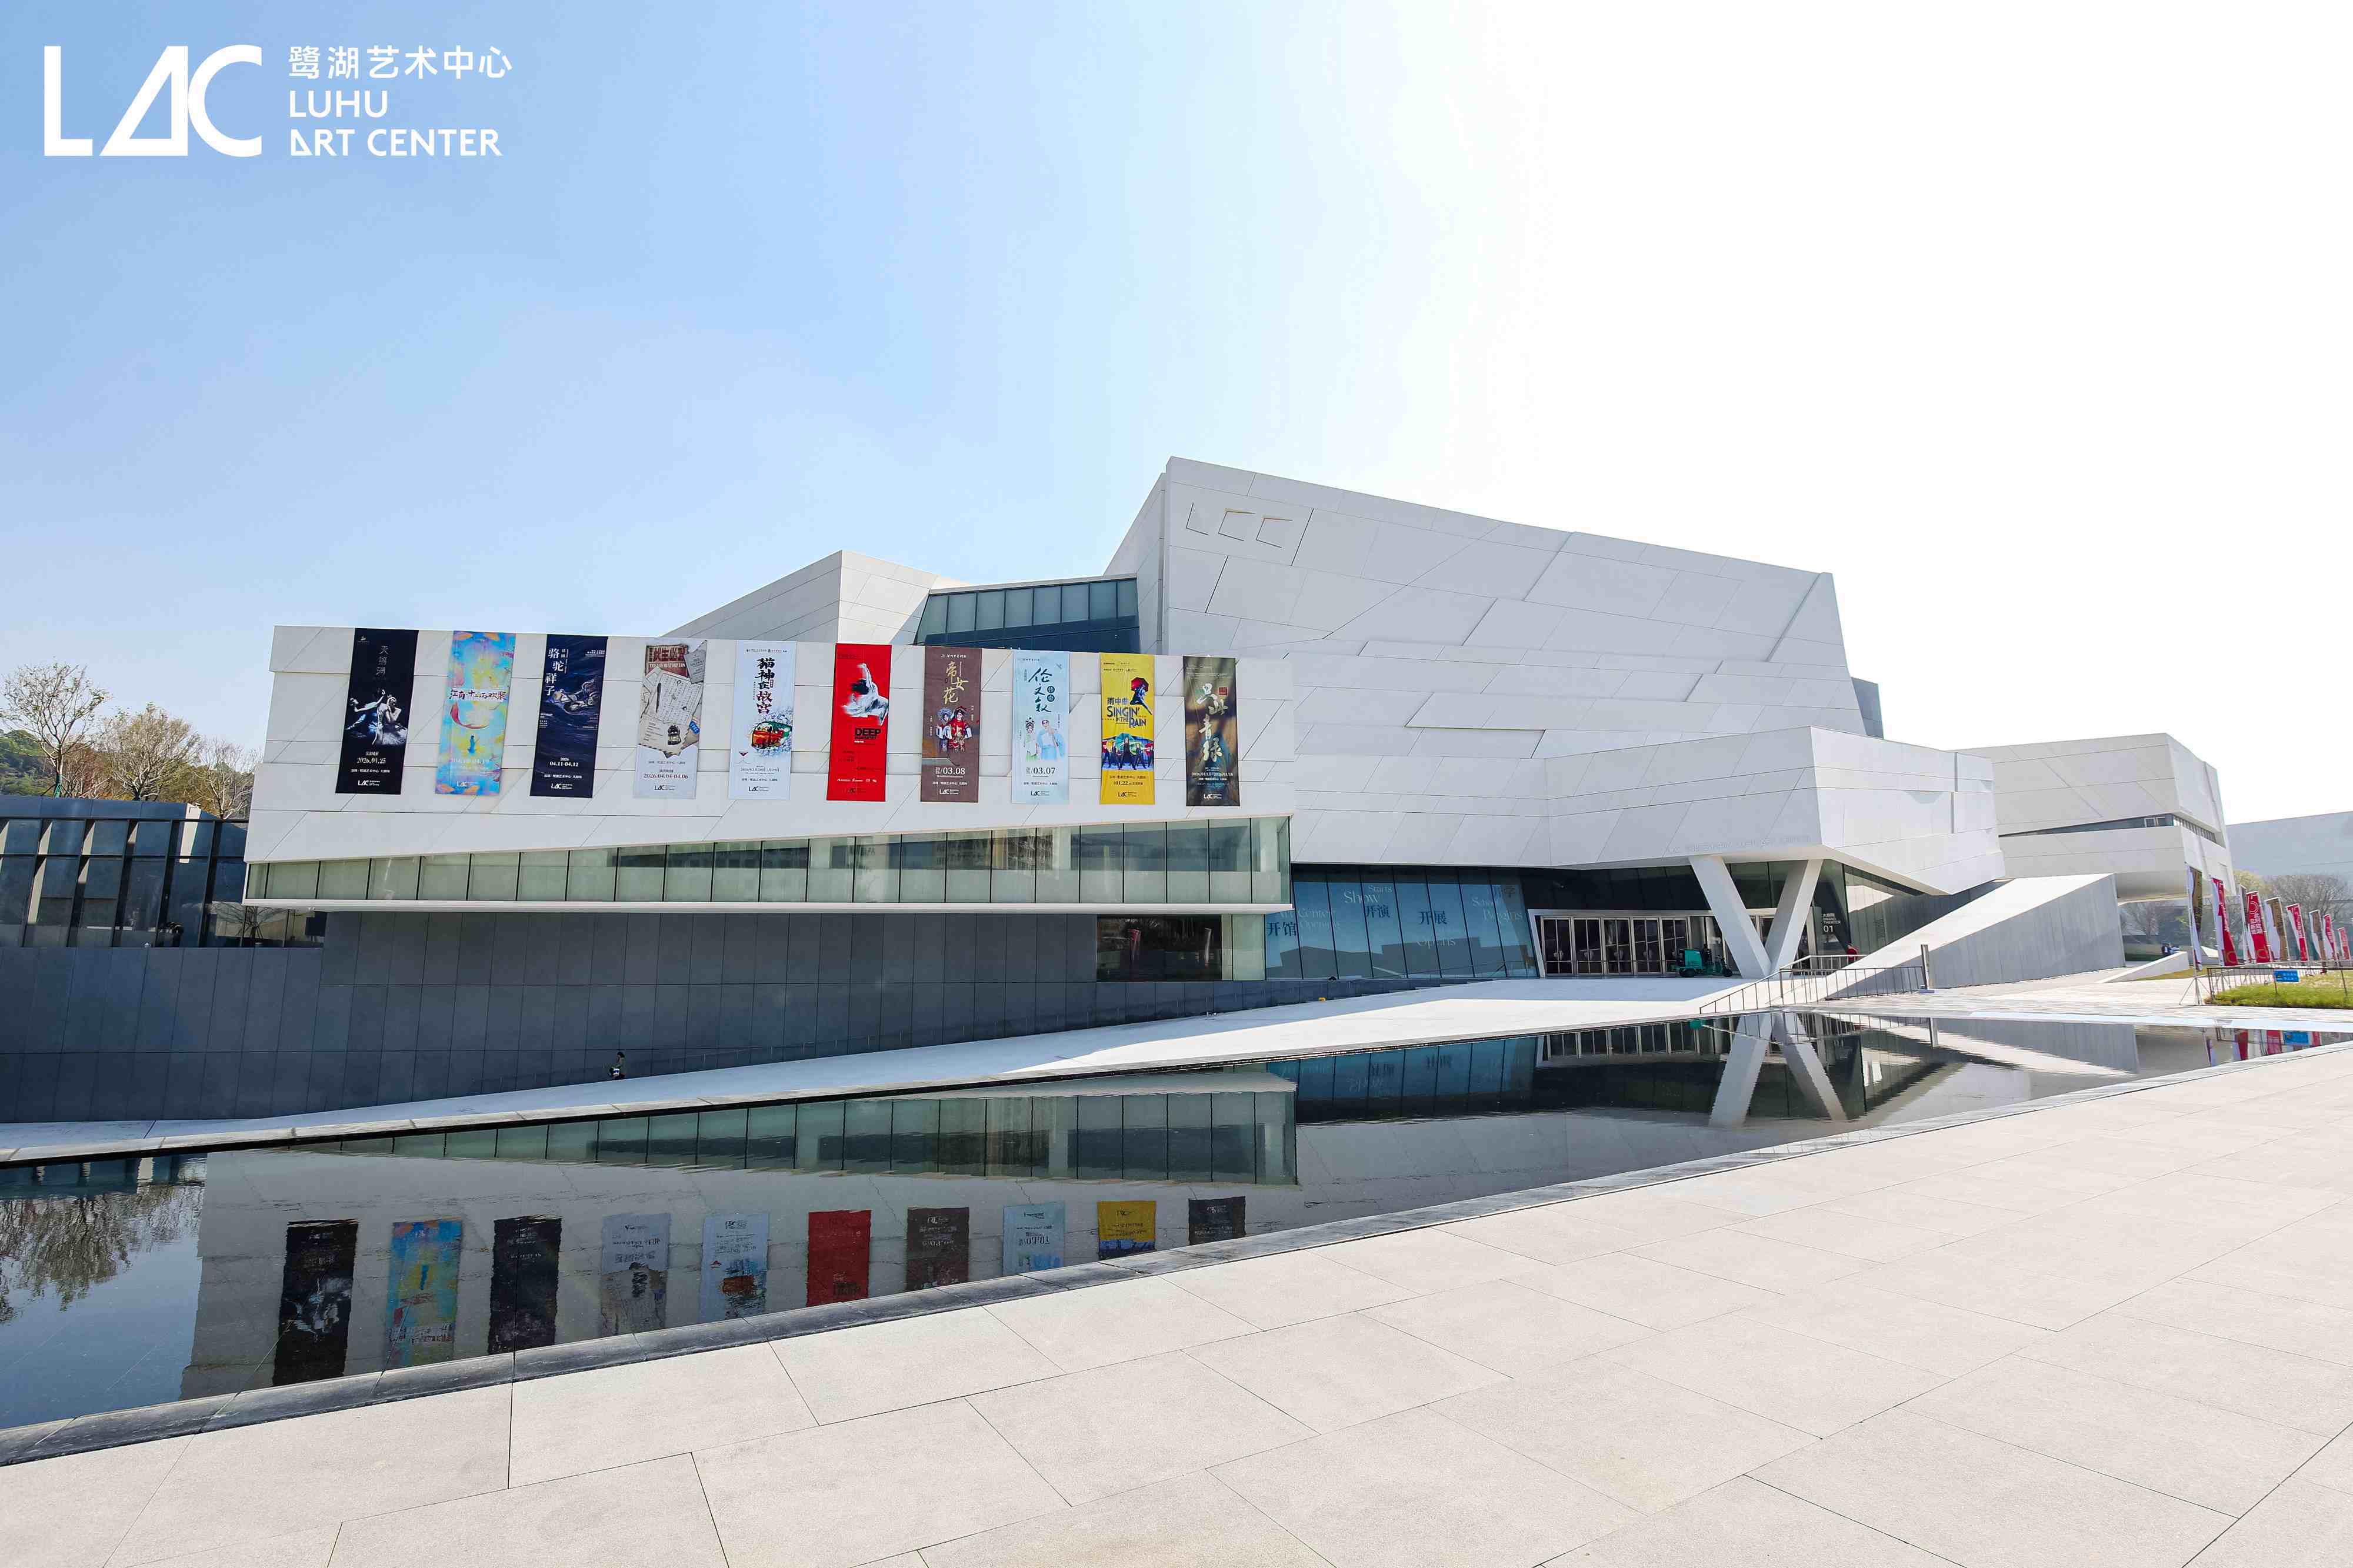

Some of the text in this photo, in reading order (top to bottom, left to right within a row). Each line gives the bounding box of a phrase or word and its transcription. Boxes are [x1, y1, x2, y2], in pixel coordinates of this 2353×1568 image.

[545, 648, 565, 696] 骆驼祥子
[755, 657, 775, 715] 猫神在故宫
[943, 660, 969, 705] 帝女花
[1028, 667, 1052, 713] 伦文叙
[1129, 718, 1147, 728] RAIN
[1368, 885, 1393, 893] Starts
[1343, 890, 1378, 904] Show
[1365, 905, 1390, 918] 开演
[1419, 910, 1448, 925] 开展
[1267, 922, 1298, 937] 开馆
